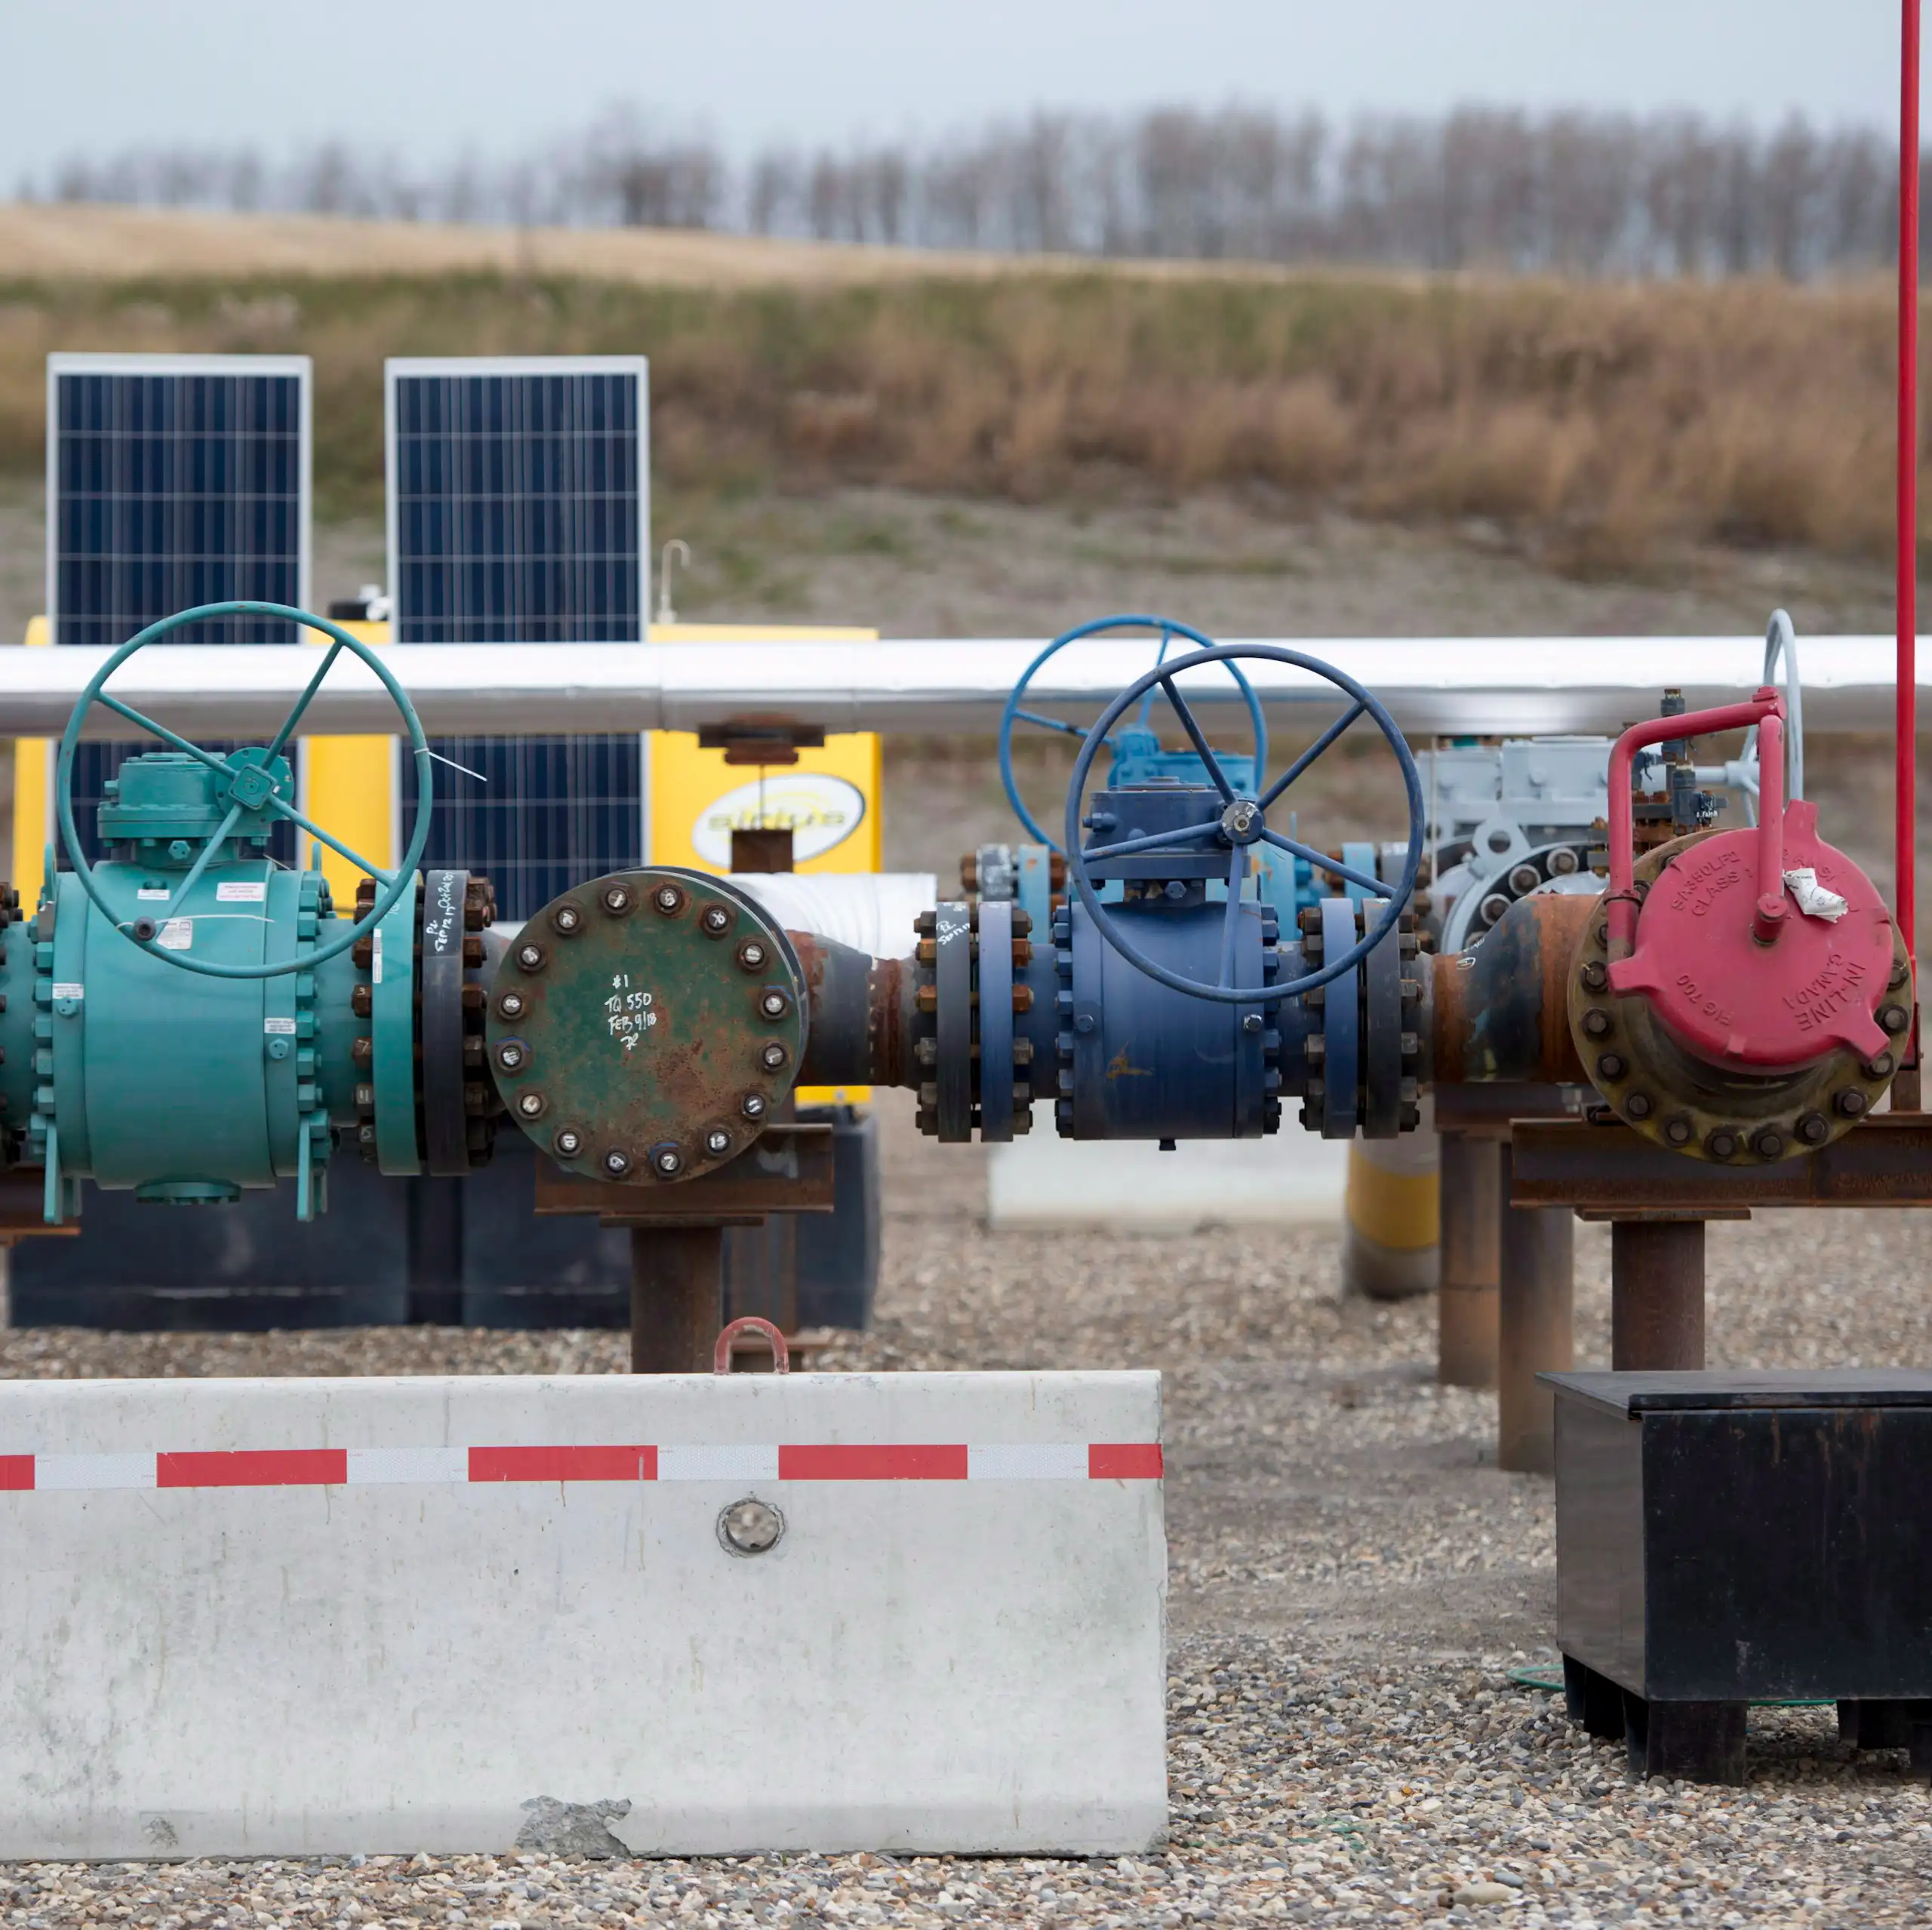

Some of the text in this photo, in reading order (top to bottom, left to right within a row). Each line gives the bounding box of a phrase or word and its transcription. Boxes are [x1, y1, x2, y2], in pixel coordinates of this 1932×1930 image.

[626, 991, 652, 1010] 550
[1794, 962, 1866, 1031] IN-LINE
[608, 1014, 633, 1036] FEB
